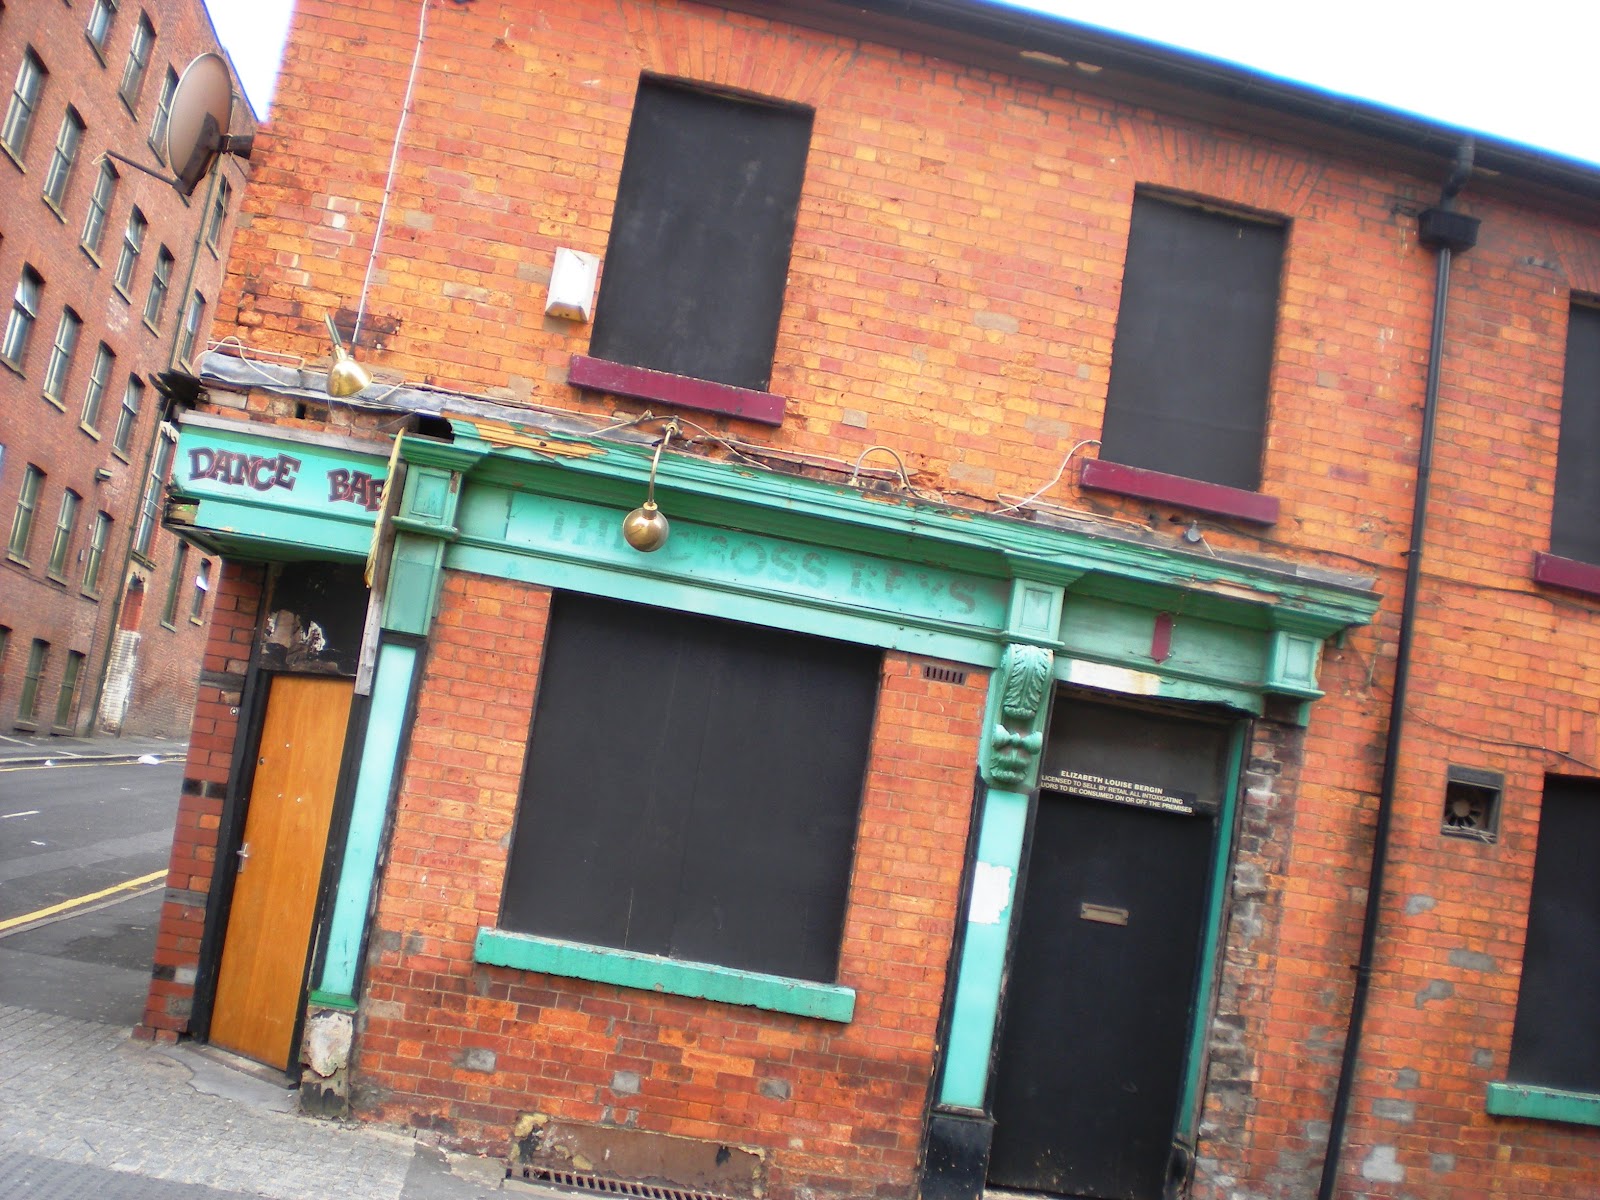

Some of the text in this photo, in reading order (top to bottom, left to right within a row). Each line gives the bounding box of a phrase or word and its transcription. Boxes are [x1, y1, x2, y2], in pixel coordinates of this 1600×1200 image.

[187, 446, 301, 491] DANCE
[1041, 775, 1072, 785] LICENSED
[1082, 782, 1097, 790] SELL
[1108, 787, 1129, 796] RETAIL
[1129, 790, 1141, 798] ALL
[1142, 793, 1184, 805] INTOXICATING
[1061, 770, 1163, 794] ELIZABETH LOUISE BERGIN
[1078, 789, 1114, 800] CONSUMED
[1161, 803, 1193, 813] PREMISES
